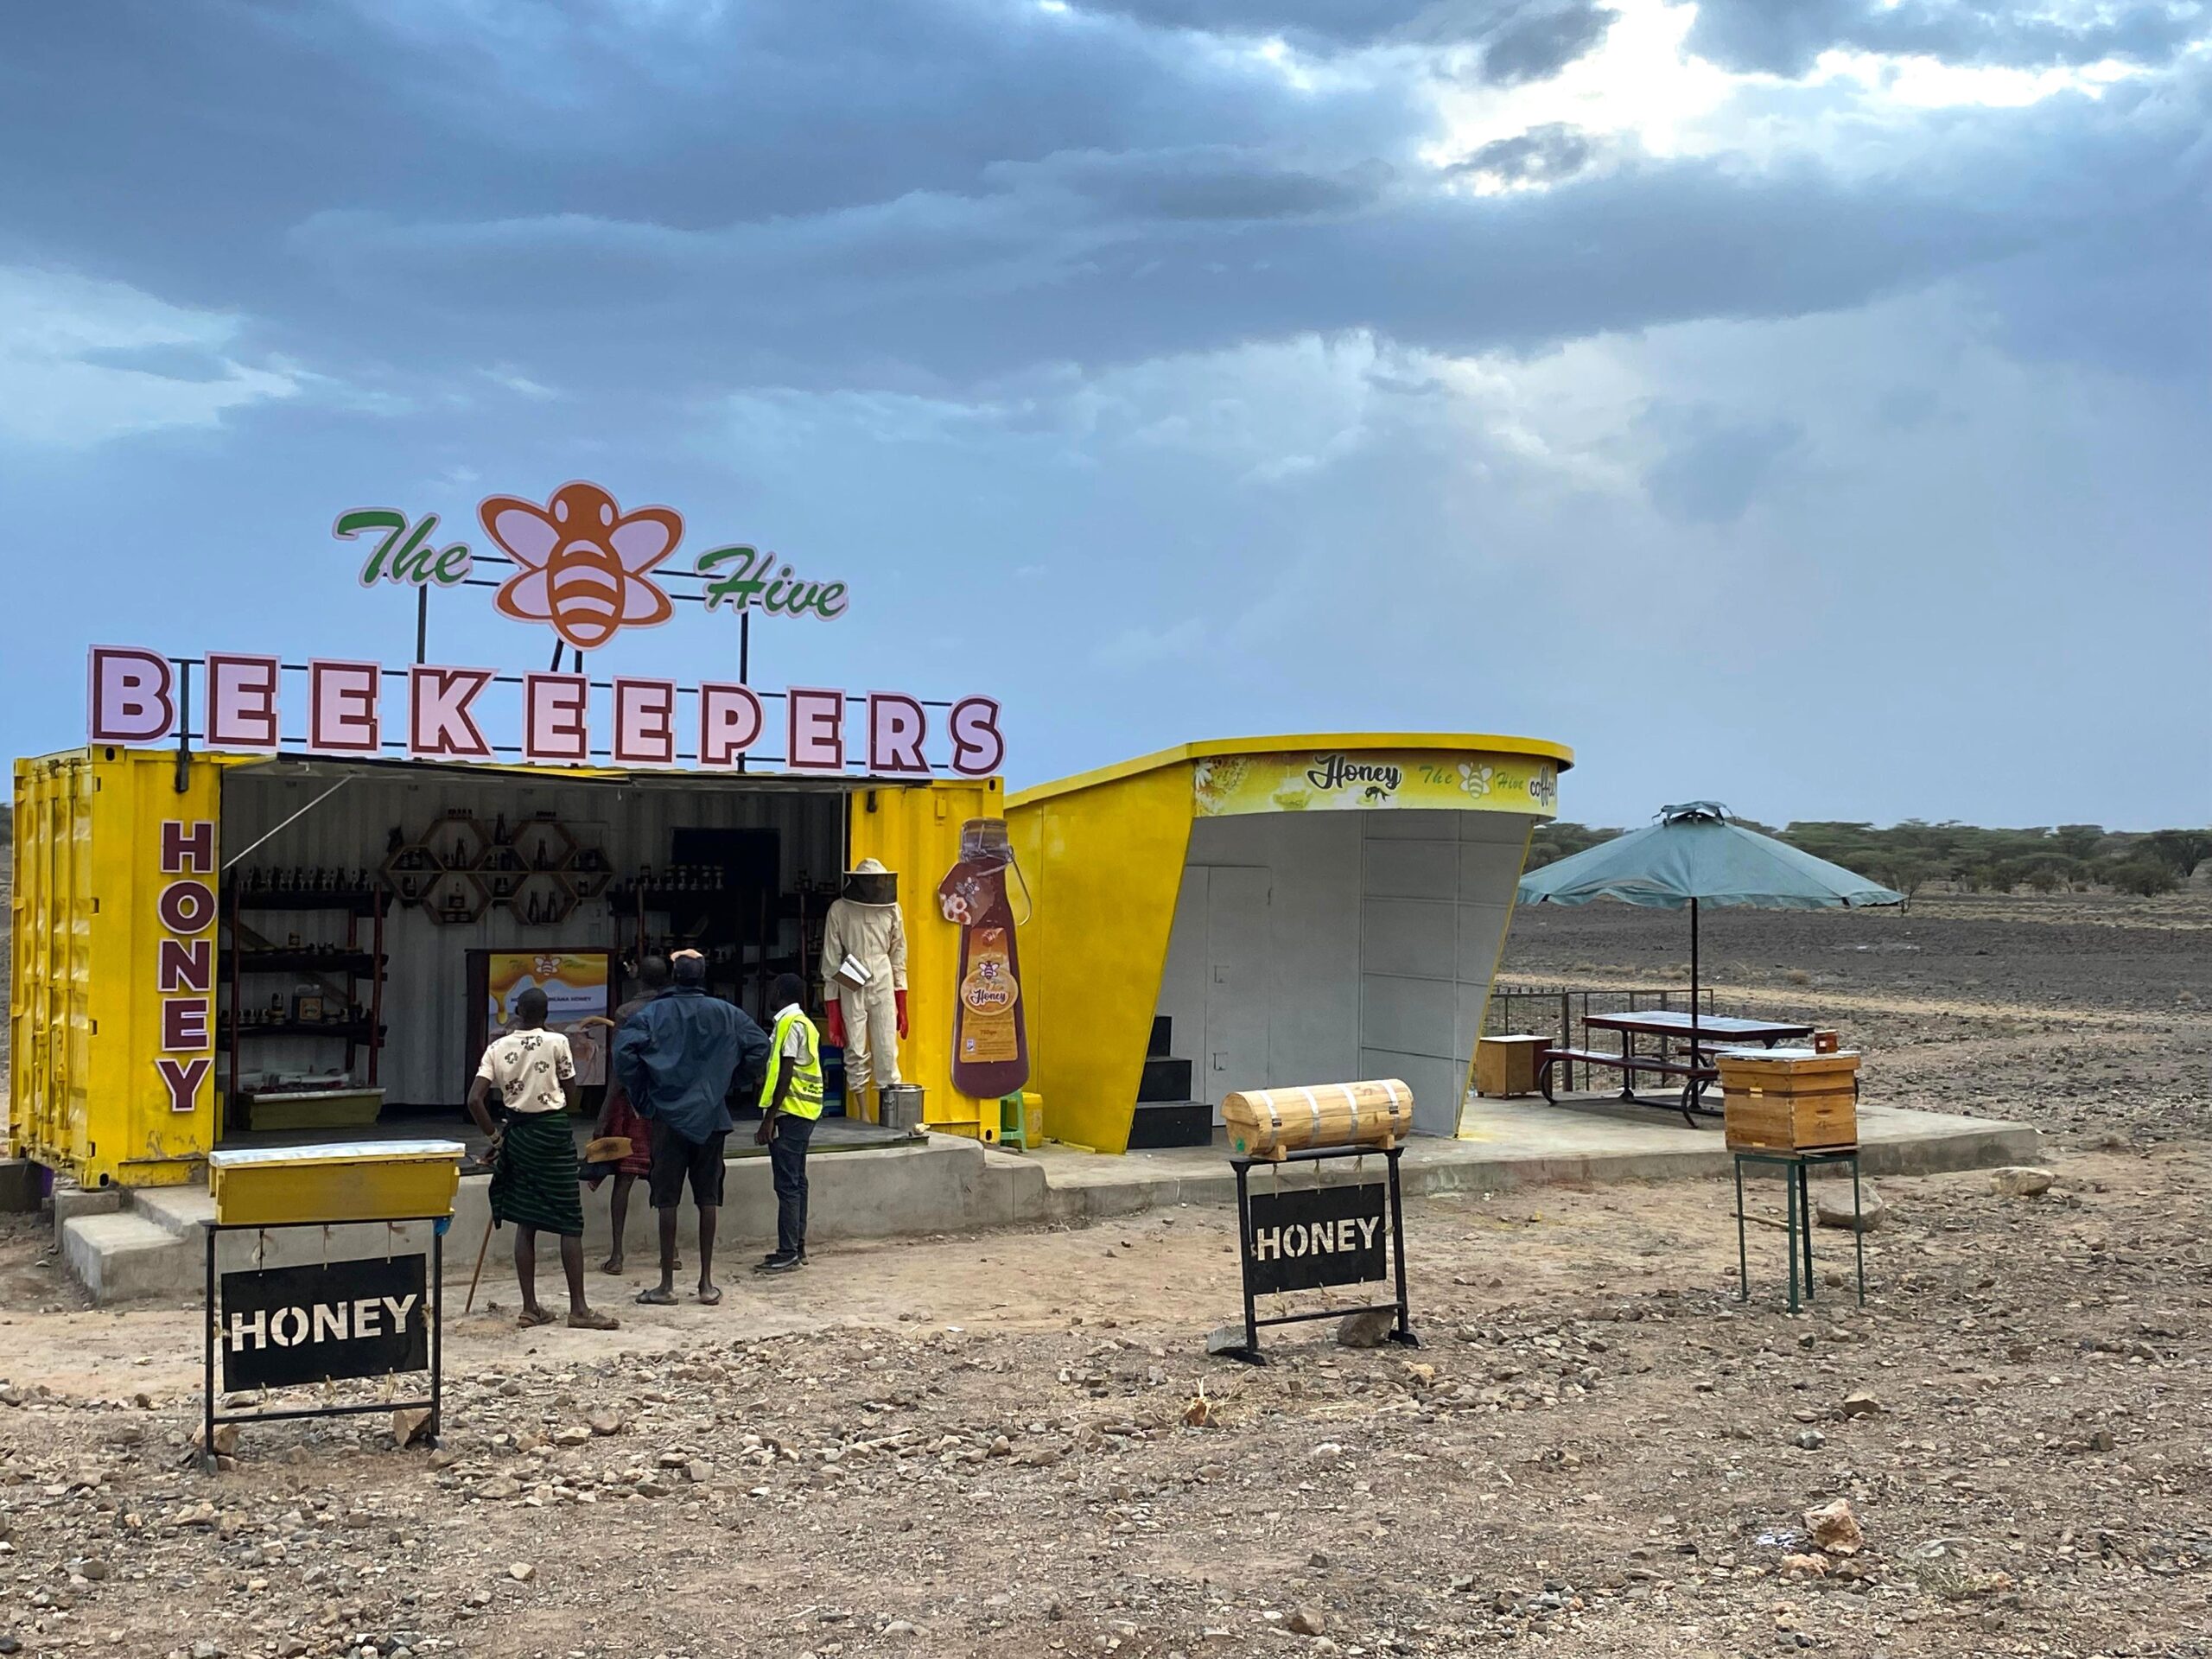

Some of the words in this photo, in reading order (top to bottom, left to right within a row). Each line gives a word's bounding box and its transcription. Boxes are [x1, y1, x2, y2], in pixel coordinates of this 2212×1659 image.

[336, 510, 469, 583] The
[697, 547, 846, 616] Hive
[92, 648, 1005, 776] BEEKEEPERS
[1306, 754, 1402, 791] Honey
[1419, 765, 1452, 785] The
[1496, 772, 1524, 790] Hive
[157, 820, 217, 1111] HONEY
[969, 988, 1007, 1004] Honey
[1256, 1216, 1381, 1262] HONEY
[230, 1294, 418, 1352] HONEY
